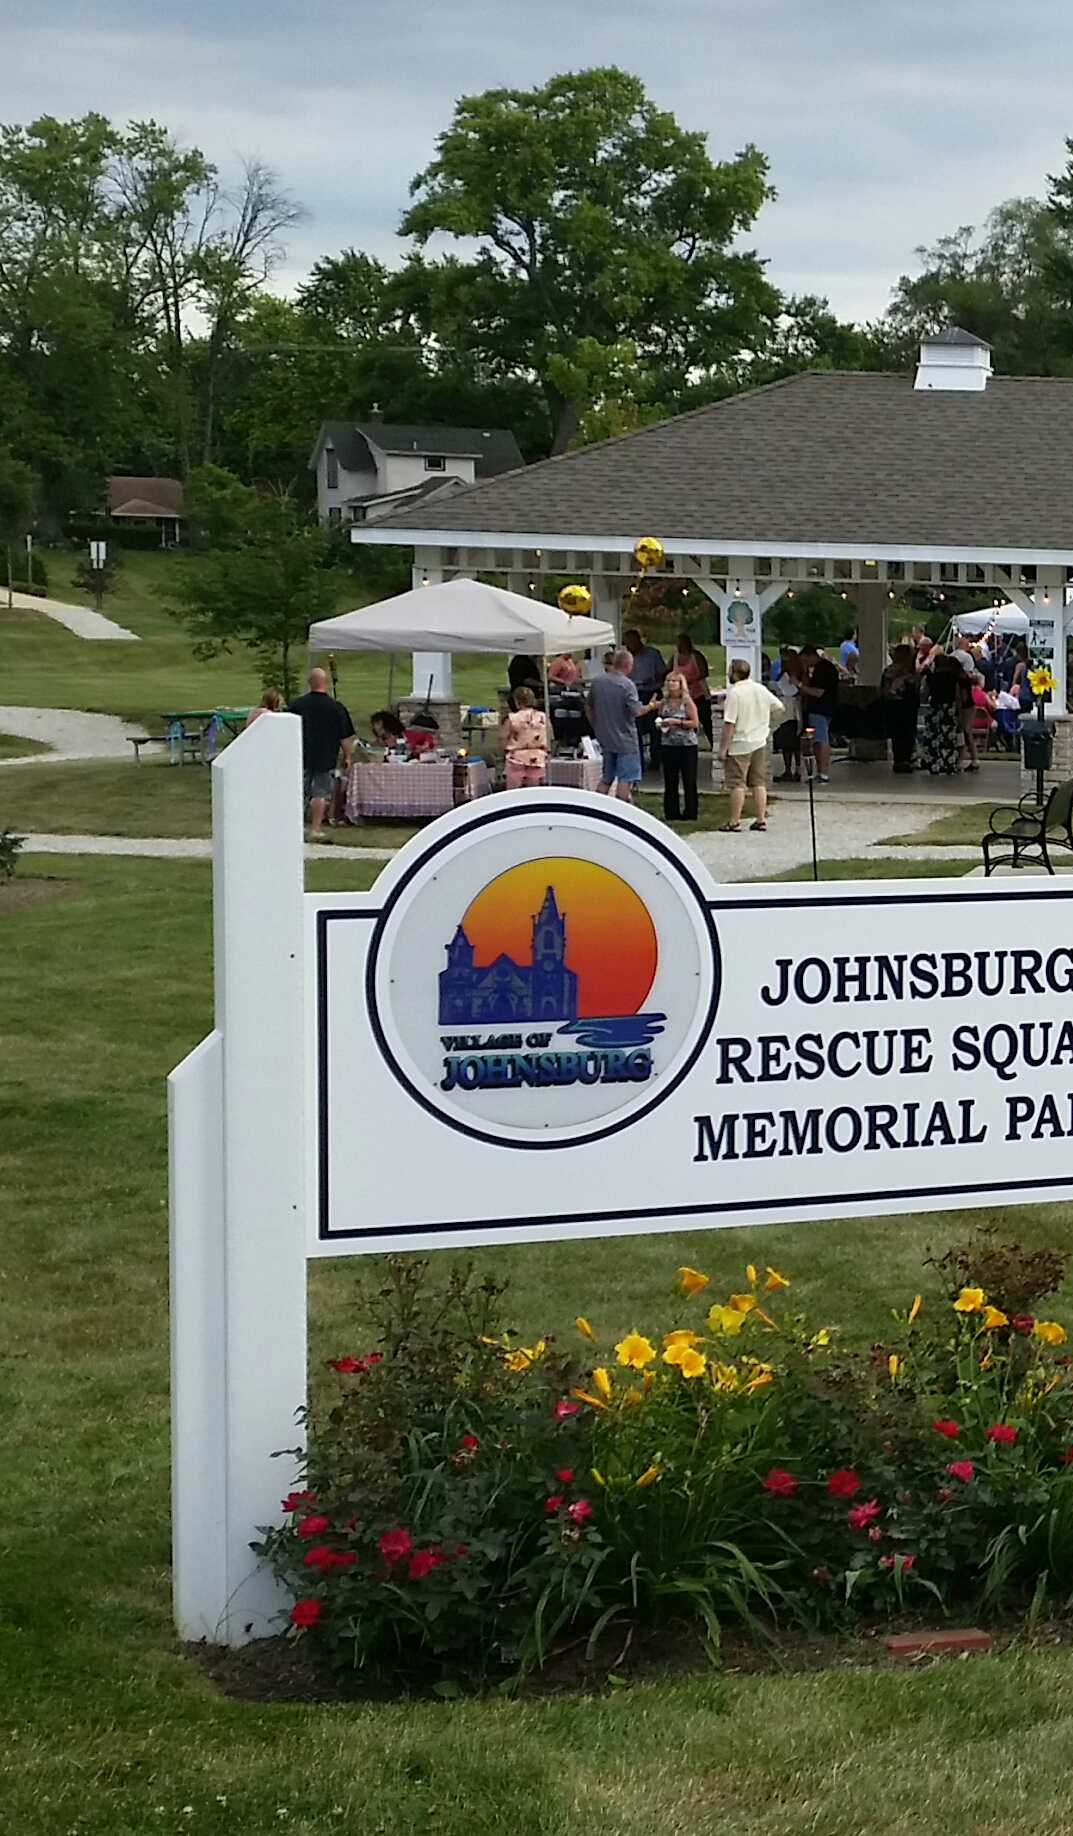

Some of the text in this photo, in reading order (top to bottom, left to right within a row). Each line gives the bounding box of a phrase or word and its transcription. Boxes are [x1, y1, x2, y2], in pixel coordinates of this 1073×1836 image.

[440, 1032, 552, 1051] VILLAGE OF
[716, 1029, 933, 1085] RESCUE
[441, 1048, 653, 1091] JOHNSBURG
[694, 1099, 988, 1162] MEMORIAL
